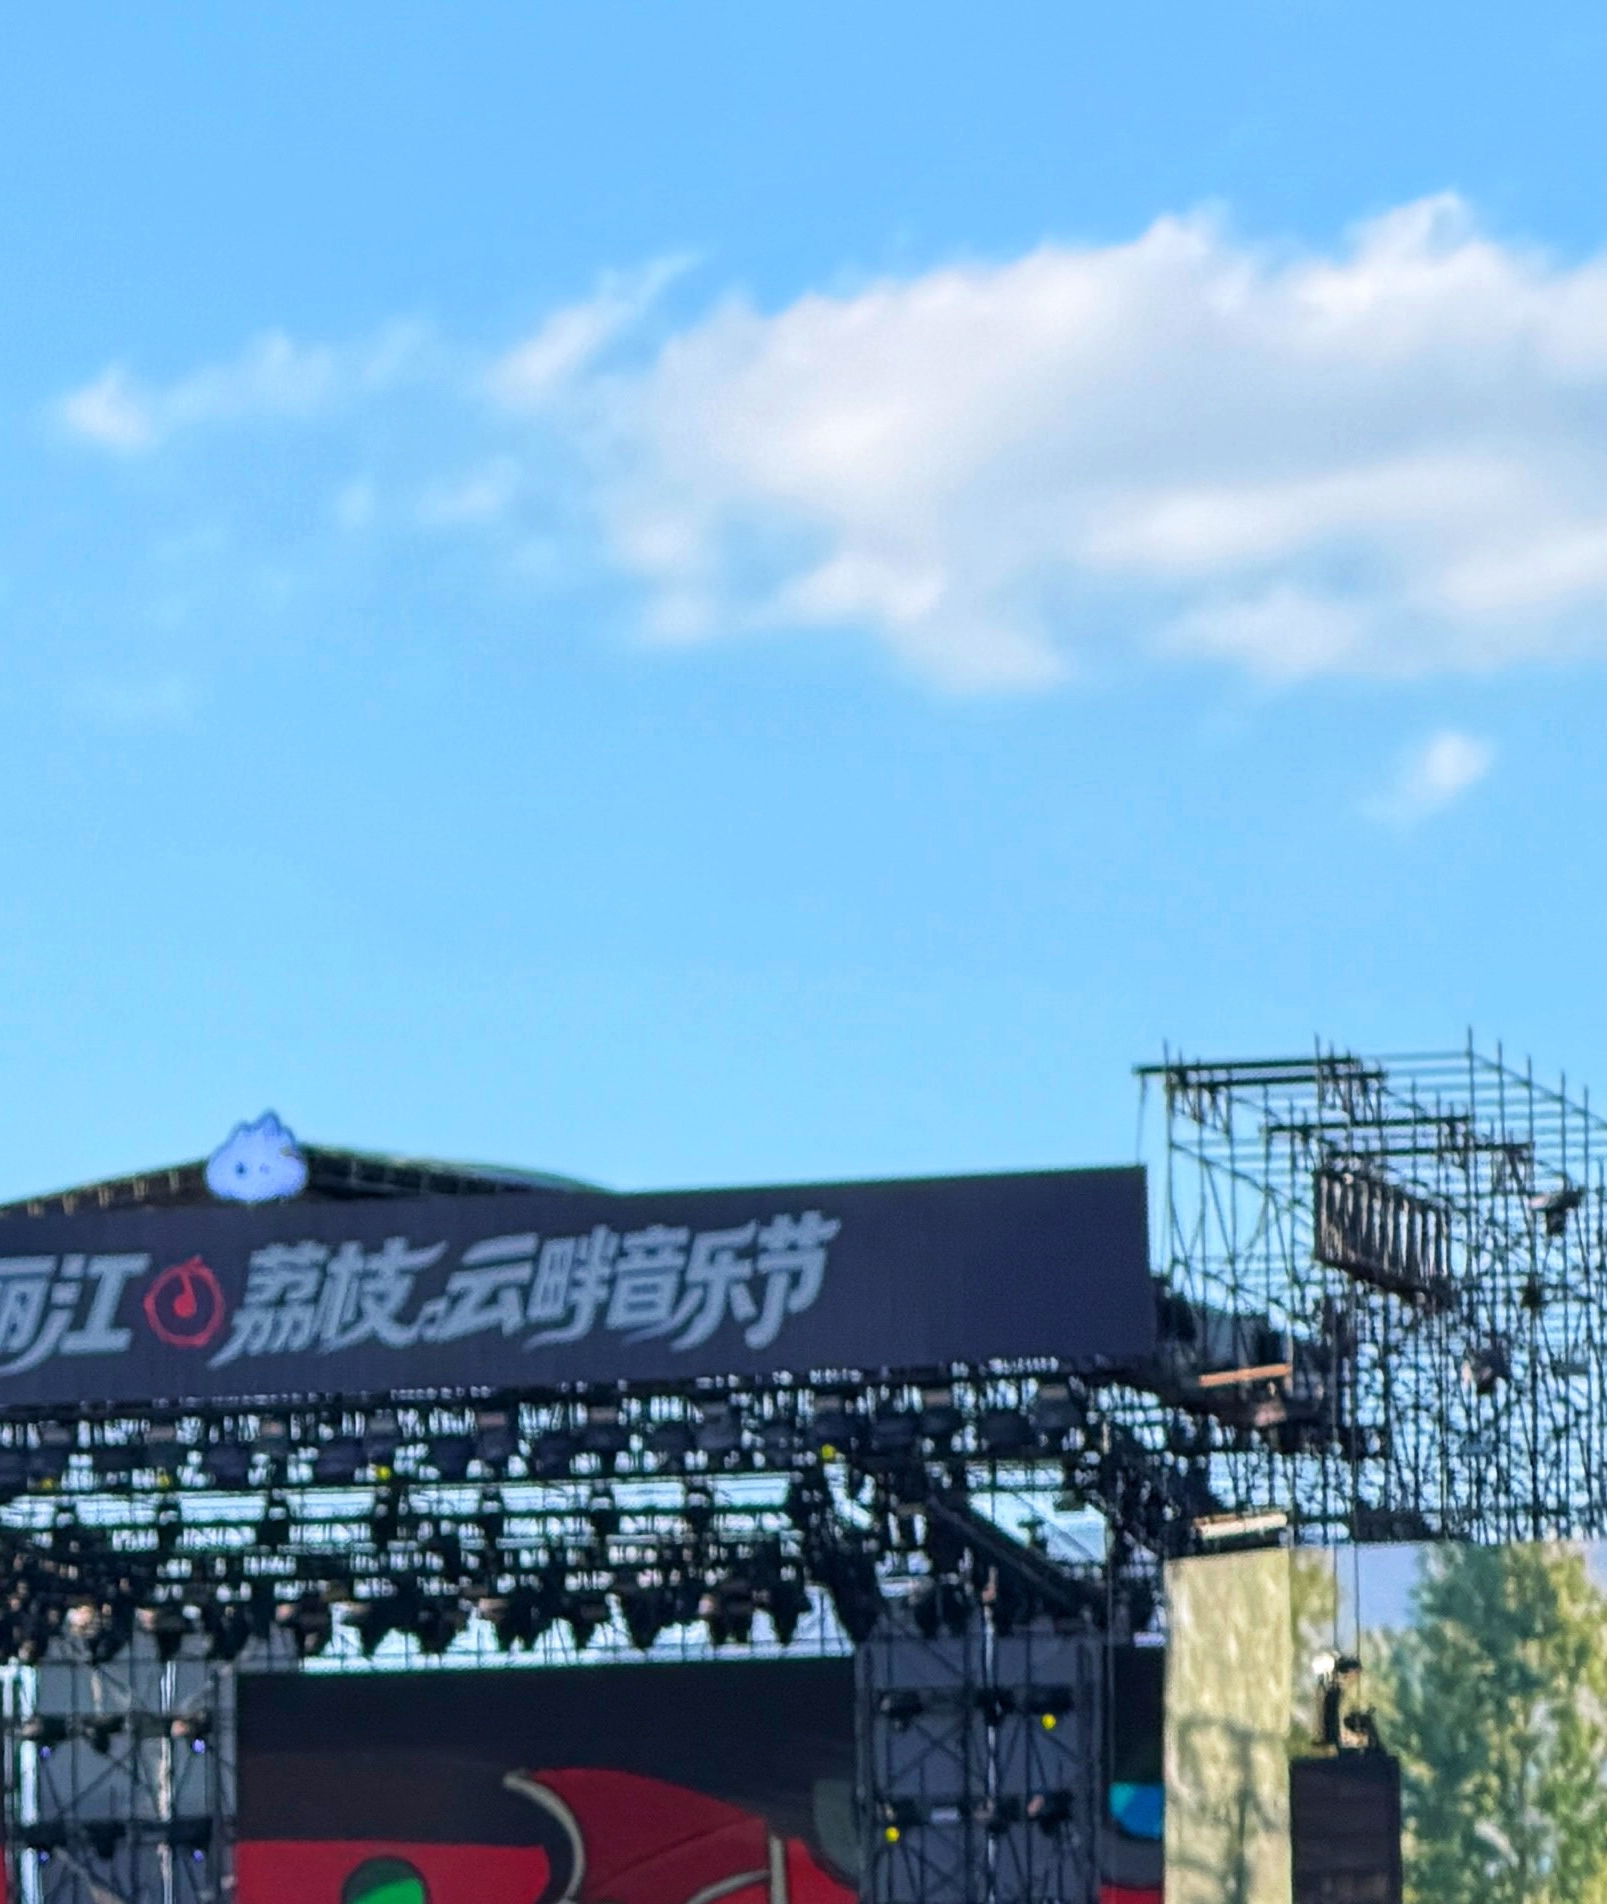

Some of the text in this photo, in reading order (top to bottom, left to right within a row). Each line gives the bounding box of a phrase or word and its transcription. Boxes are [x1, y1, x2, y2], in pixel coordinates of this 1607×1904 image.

[207, 1208, 843, 1371] 荔枝云畔音乐节
